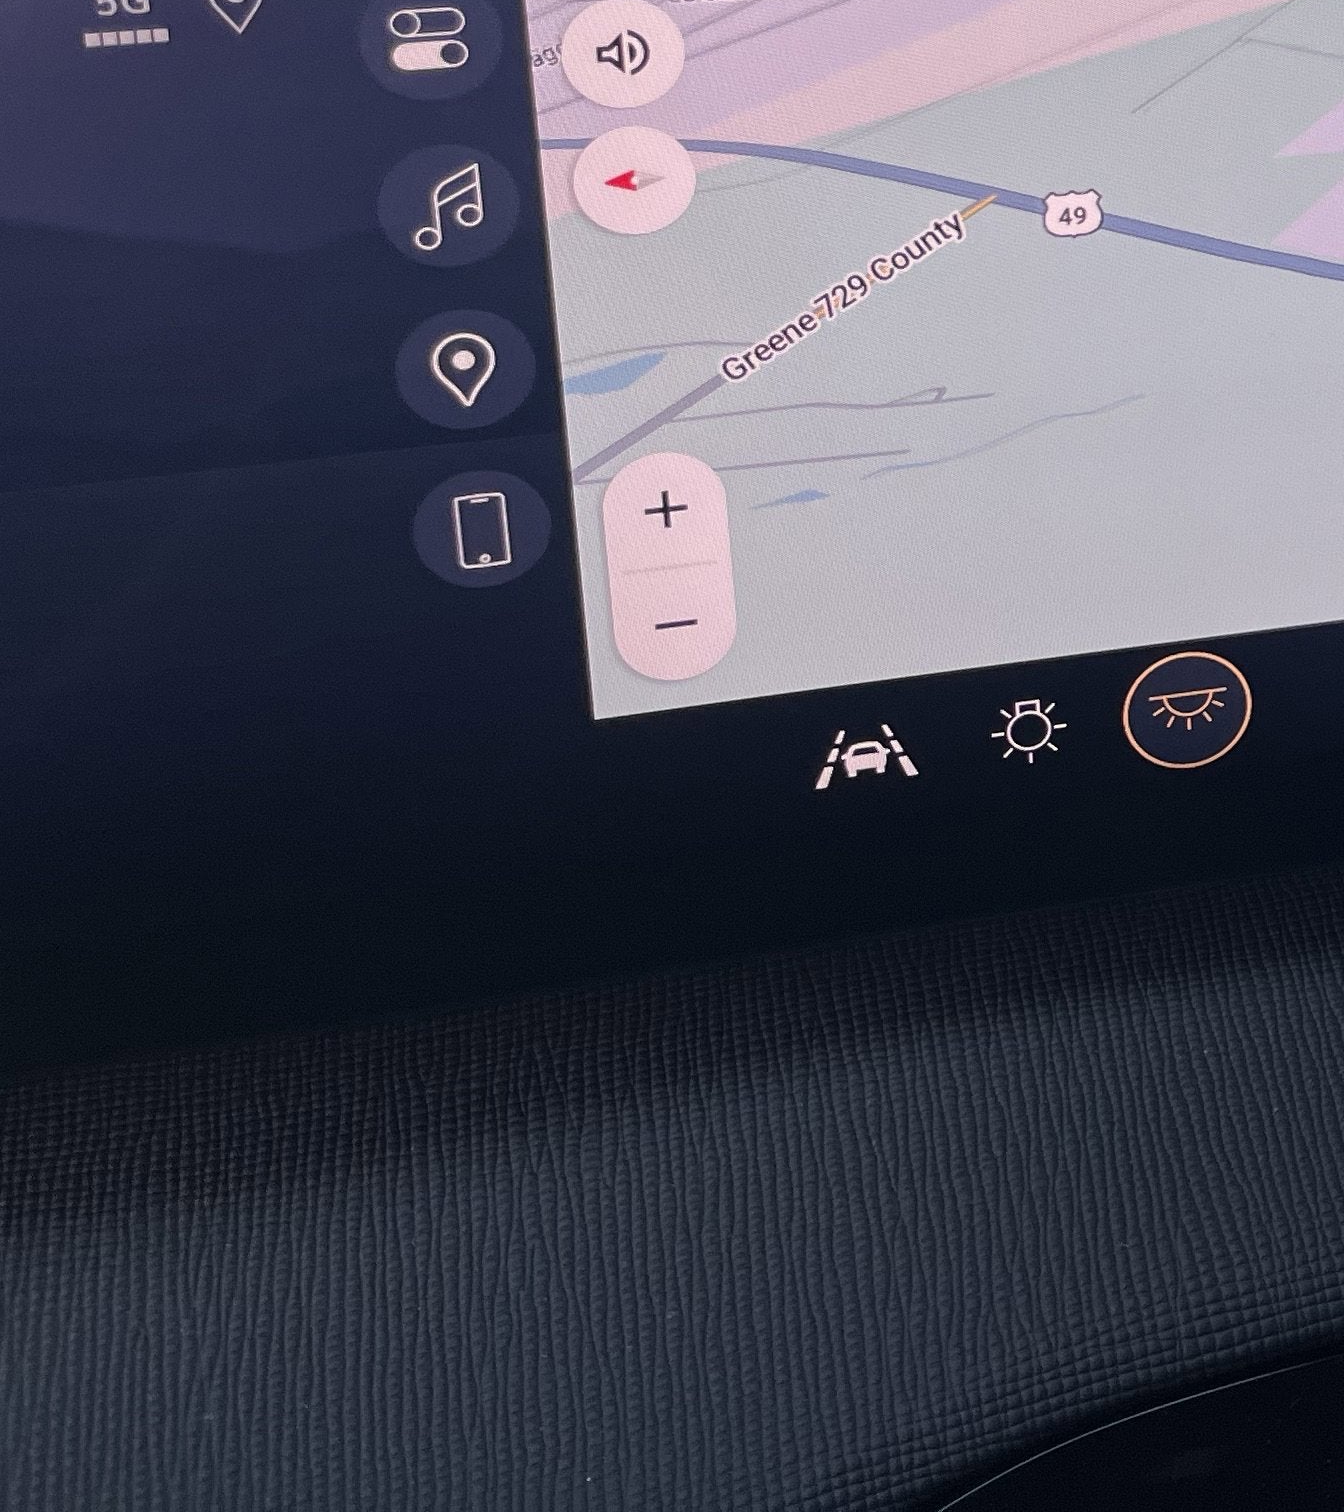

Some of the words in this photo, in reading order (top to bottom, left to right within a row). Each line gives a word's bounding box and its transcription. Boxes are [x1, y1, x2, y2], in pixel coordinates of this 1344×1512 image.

[1059, 206, 1087, 225] 49
[721, 311, 818, 381] Greene
[813, 273, 869, 319] 729
[869, 213, 966, 281] County
